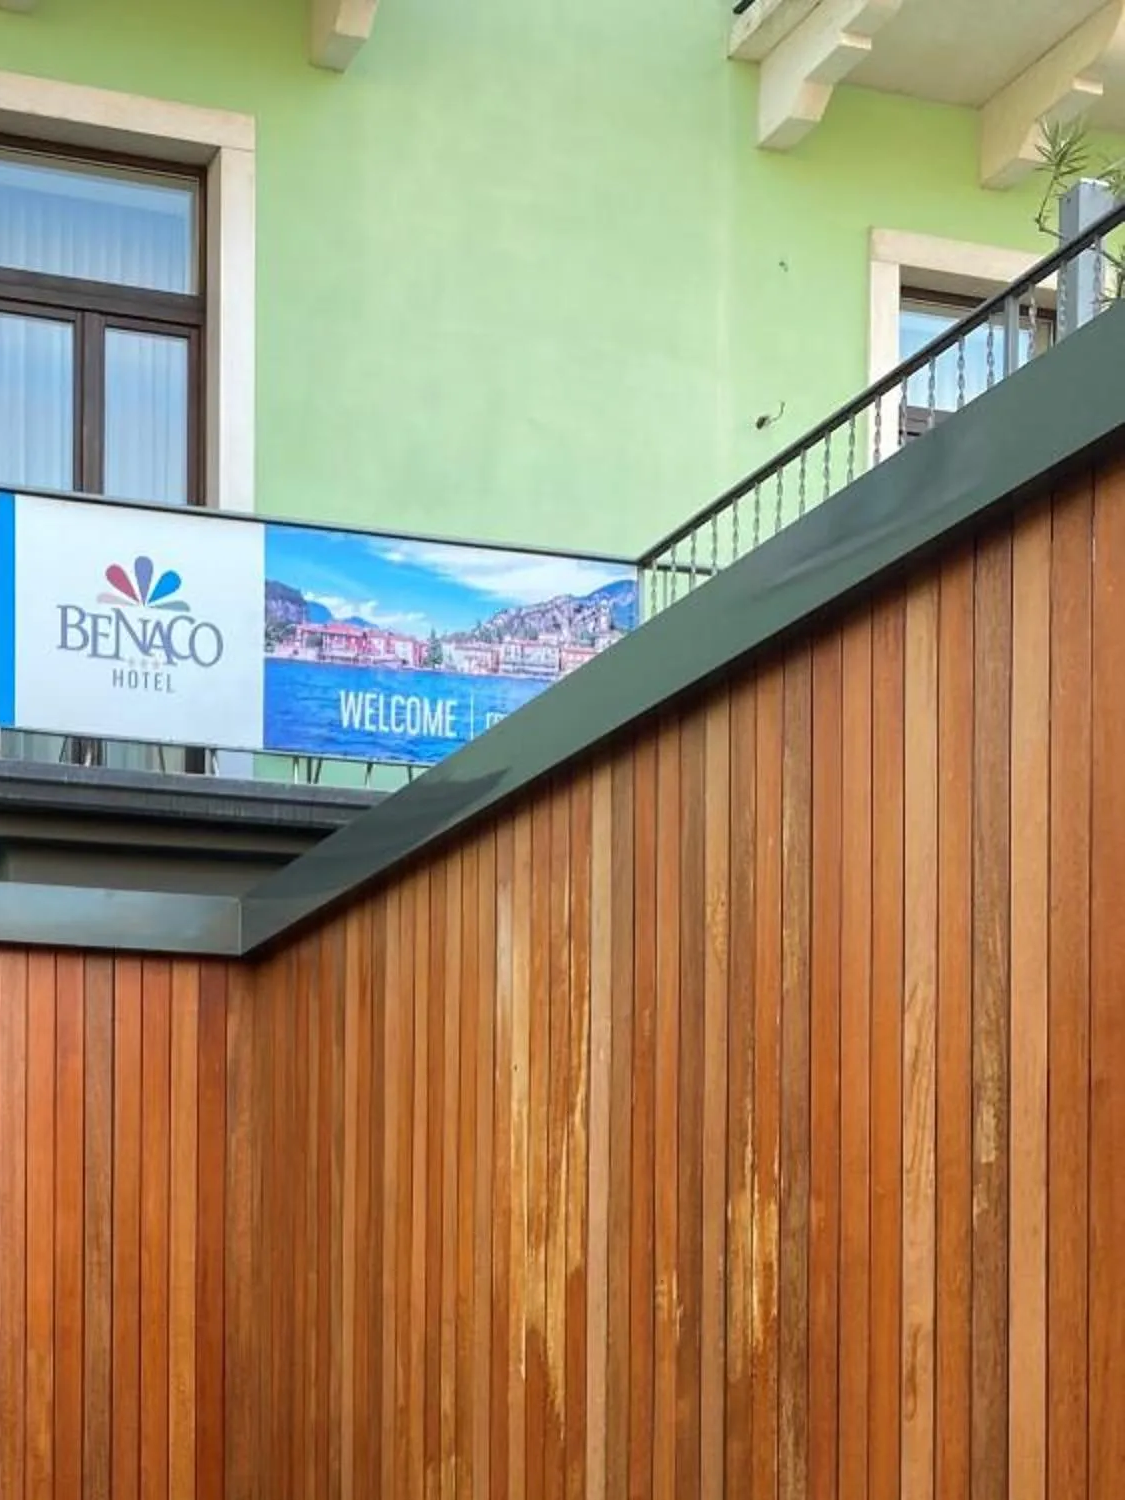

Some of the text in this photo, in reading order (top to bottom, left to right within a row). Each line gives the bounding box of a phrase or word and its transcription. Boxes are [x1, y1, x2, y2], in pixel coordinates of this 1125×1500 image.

[56, 604, 224, 668] BENACO
[112, 668, 176, 693] HOTEL
[339, 689, 458, 738] WELCOME
